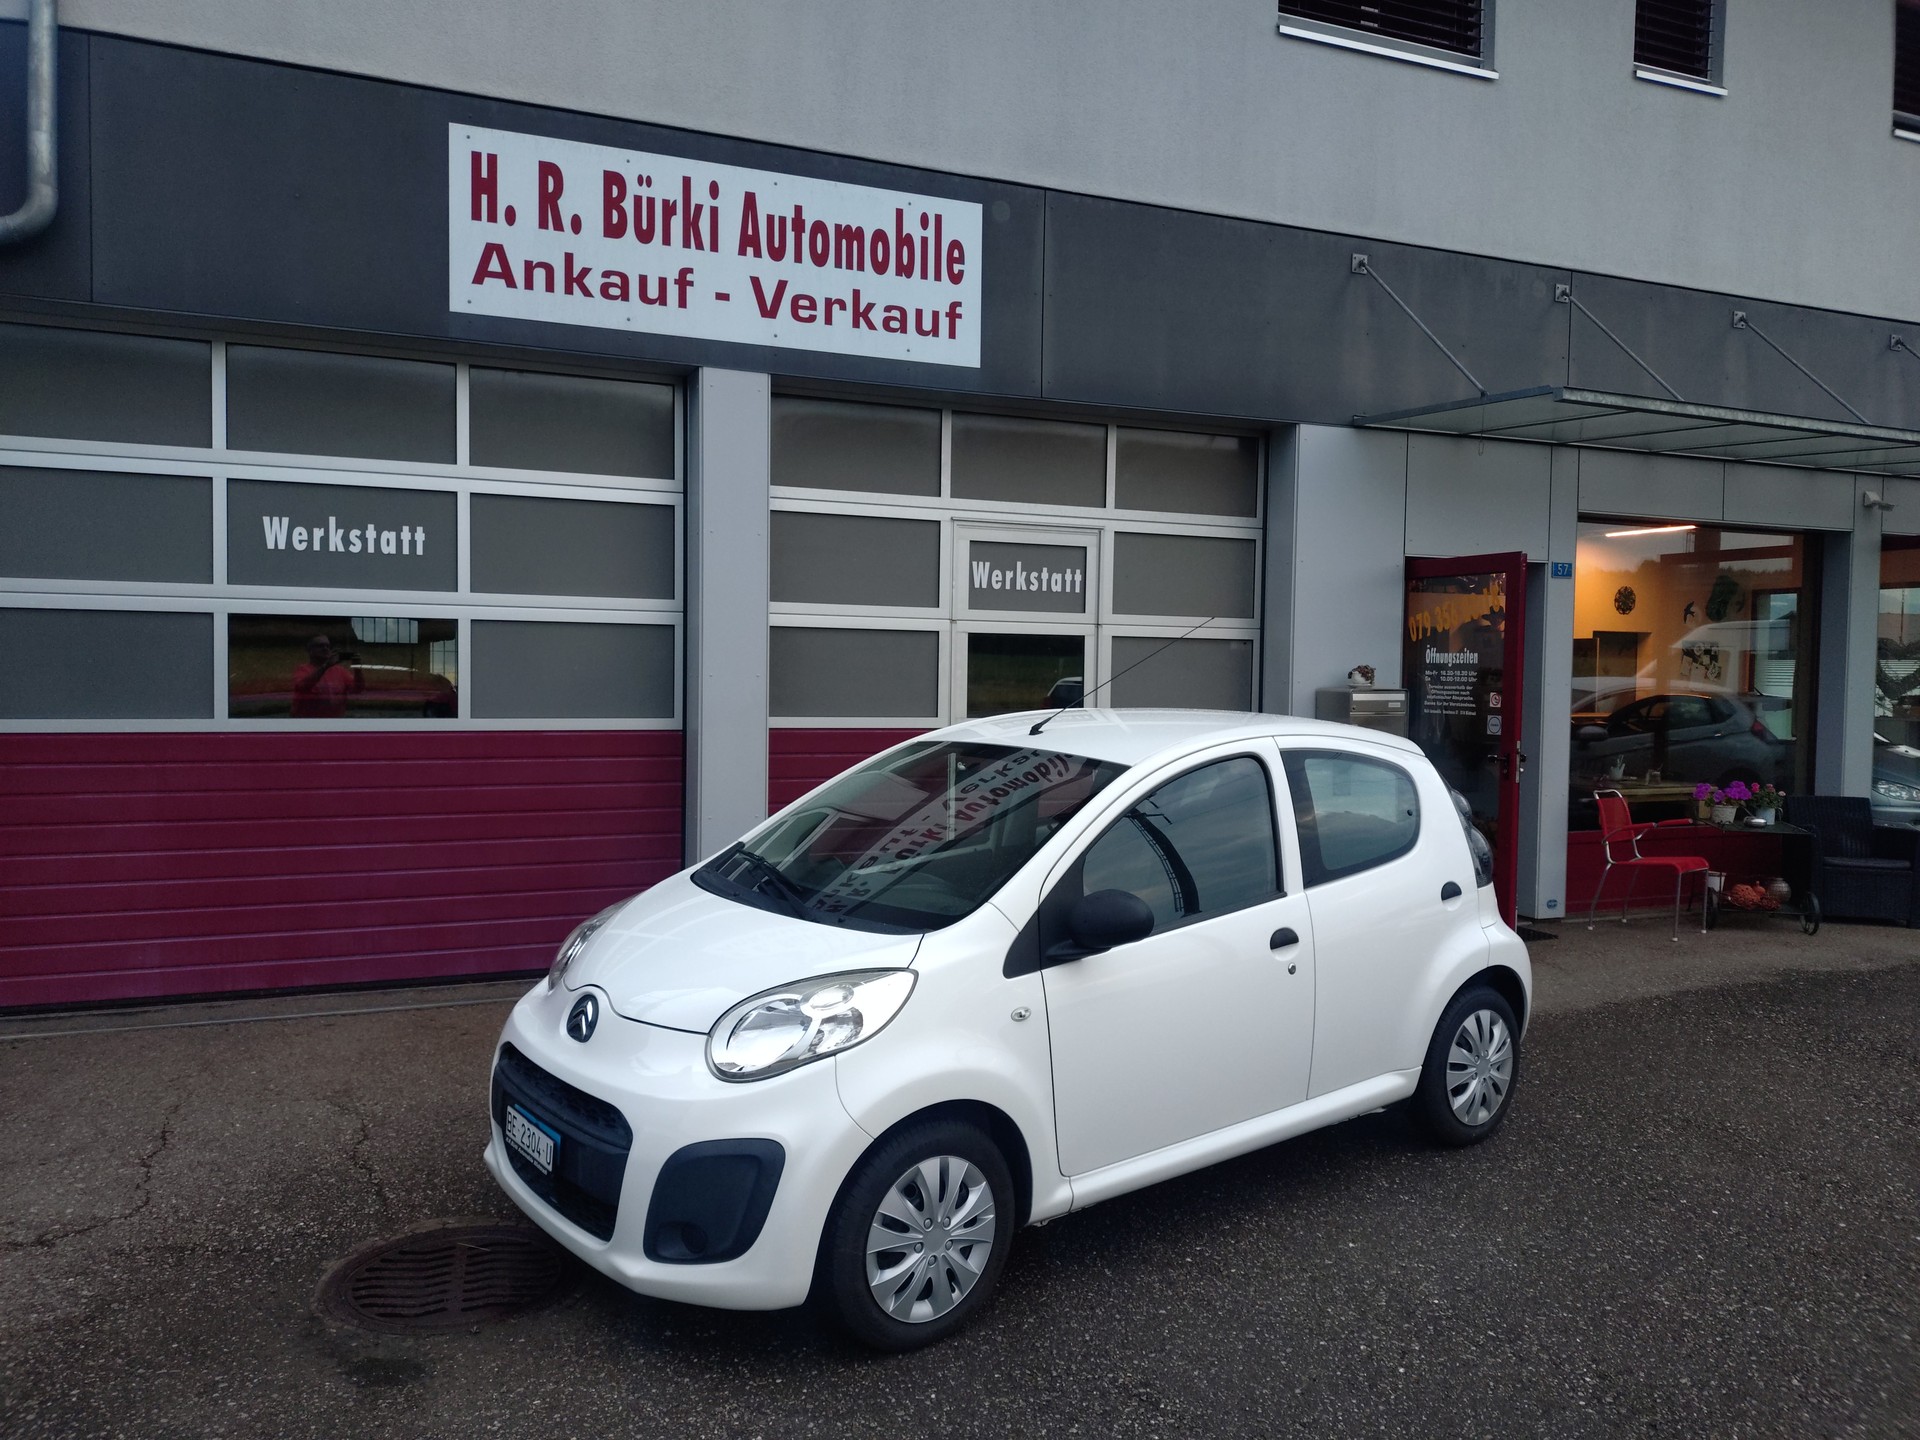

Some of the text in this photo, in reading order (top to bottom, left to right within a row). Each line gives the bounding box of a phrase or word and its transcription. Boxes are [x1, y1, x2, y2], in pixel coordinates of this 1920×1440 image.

[469, 150, 966, 286] H. R. Bürki Automobile
[471, 241, 695, 309] Ankauf
[748, 275, 964, 340] Verkauf
[262, 515, 426, 556] Werkstatt
[971, 560, 1082, 593] Werkstatt
[1557, 563, 1569, 576] 57
[1408, 609, 1431, 642] 079
[1425, 644, 1479, 667] Öffnungszeiten
